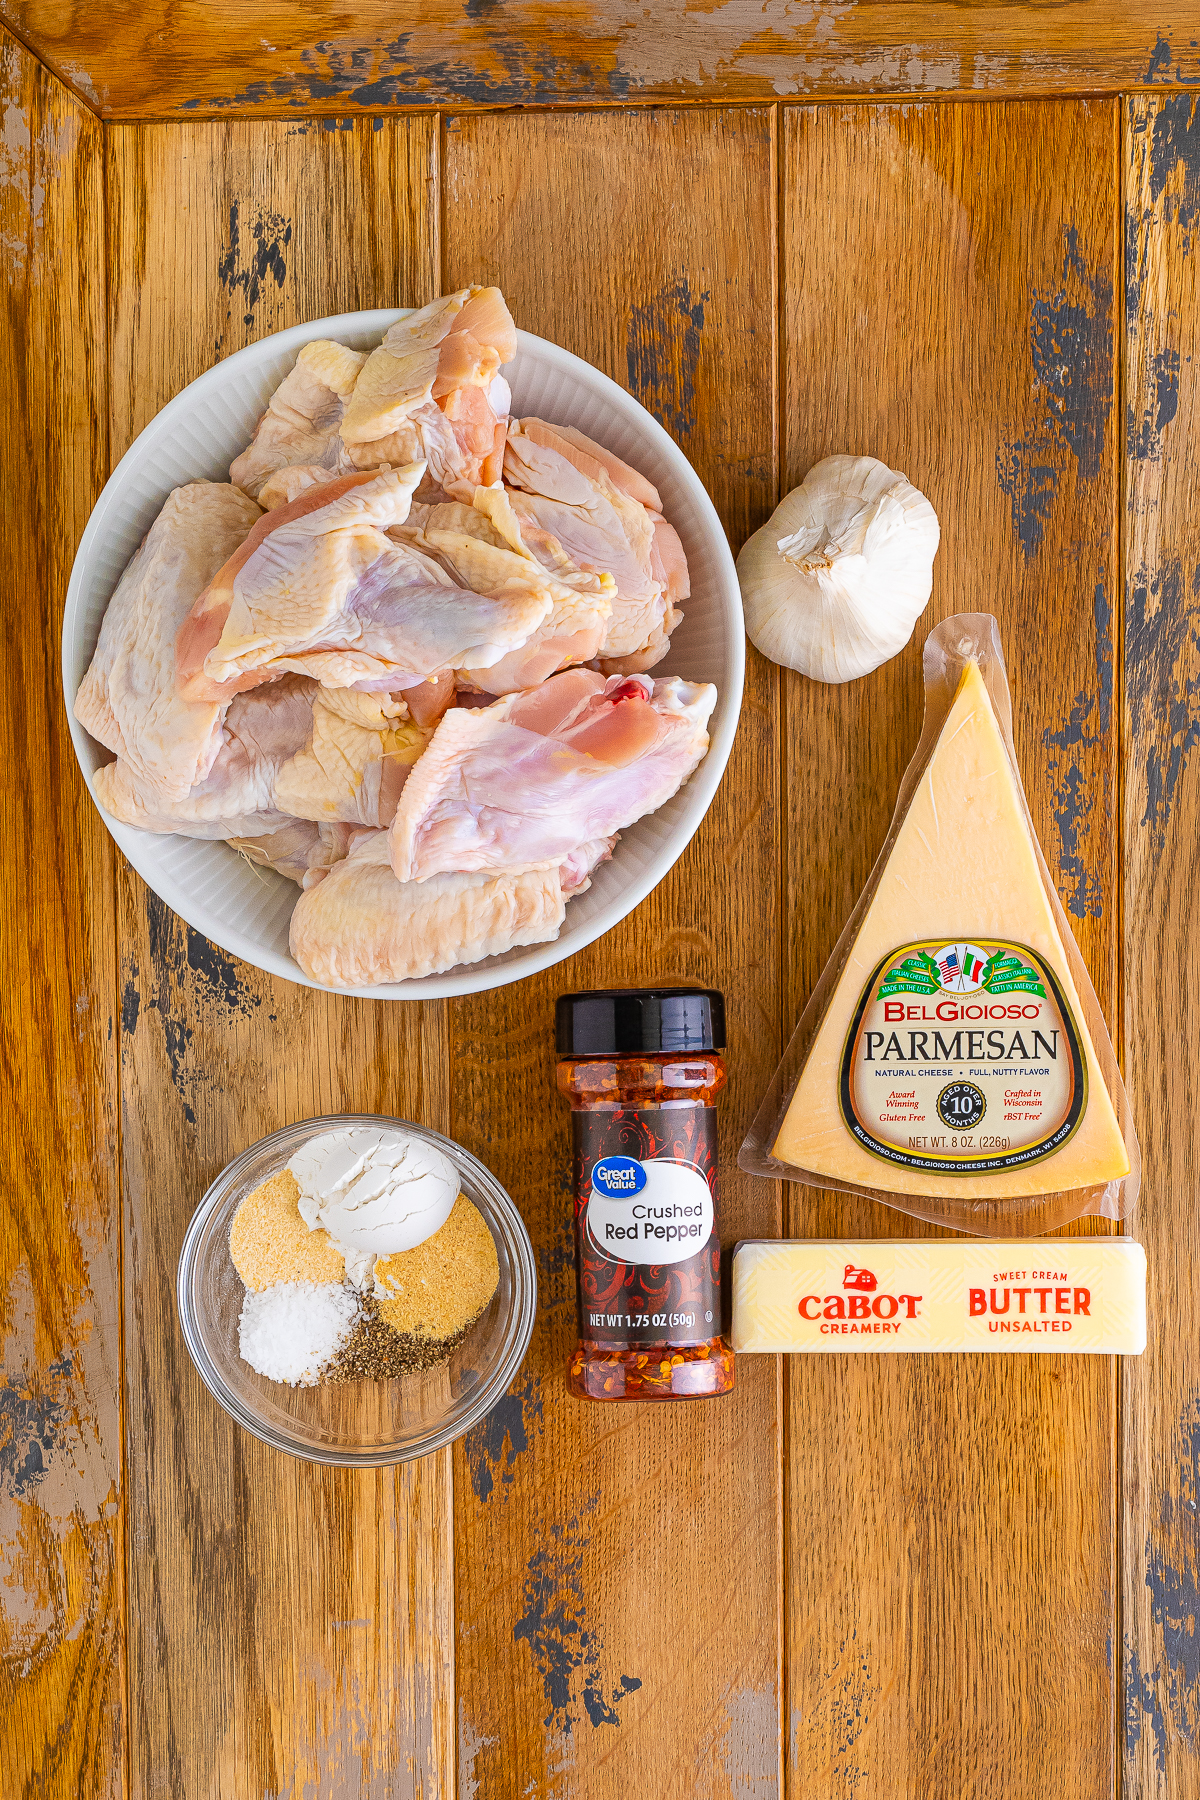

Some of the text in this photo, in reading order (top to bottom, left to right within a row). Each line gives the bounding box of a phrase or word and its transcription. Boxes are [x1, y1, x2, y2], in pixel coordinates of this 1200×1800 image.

[907, 959, 928, 969] CLASSIC
[891, 969, 930, 983] ITALIAN CHEESES
[992, 972, 1013, 982] CLASSICI
[882, 985, 898, 993] MADE
[991, 985, 1006, 993] FATTI
[1013, 982, 1038, 991] AMERICA
[938, 990, 949, 998] SAY
[864, 1030, 1060, 1061] PARMESAN
[875, 1069, 953, 1077] NATURAL CHEESE
[969, 1068, 1050, 1077] FULL, NUTTY FLAVOR
[888, 1090, 916, 1099] Award
[941, 1086, 982, 1107] AGED OVER
[1004, 1089, 1042, 1098] Crafted in
[886, 1099, 919, 1109] Winning
[950, 1096, 973, 1114] 10
[1003, 1098, 1043, 1107] Wisconsin
[879, 1113, 926, 1122] Gluten Free
[943, 1112, 980, 1126] MONTHS
[1003, 1112, 1023, 1121] rBST
[853, 1125, 907, 1163] BELGIOIOSO.COM
[911, 1158, 956, 1169] BELGIOIOSO
[956, 1162, 987, 1170] CHEESE
[987, 1160, 1004, 1168] INC.
[1005, 1148, 1044, 1165] DENMARK,
[1043, 1141, 1054, 1150] WI
[908, 1136, 1011, 1150] NET WT. 8 OZ. (226g)
[597, 1167, 636, 1181] Great
[605, 1179, 637, 1190] Value
[632, 1202, 703, 1220] Crushed
[605, 1223, 703, 1242] Red Pepper
[993, 1270, 1068, 1282] SWEET CREAM
[968, 1287, 1091, 1317] BUTTER
[589, 1312, 696, 1328] NET WT 1.75 OZ (50g)
[819, 1322, 902, 1334] CREAMERY
[988, 1320, 1073, 1333] UNSALTED
